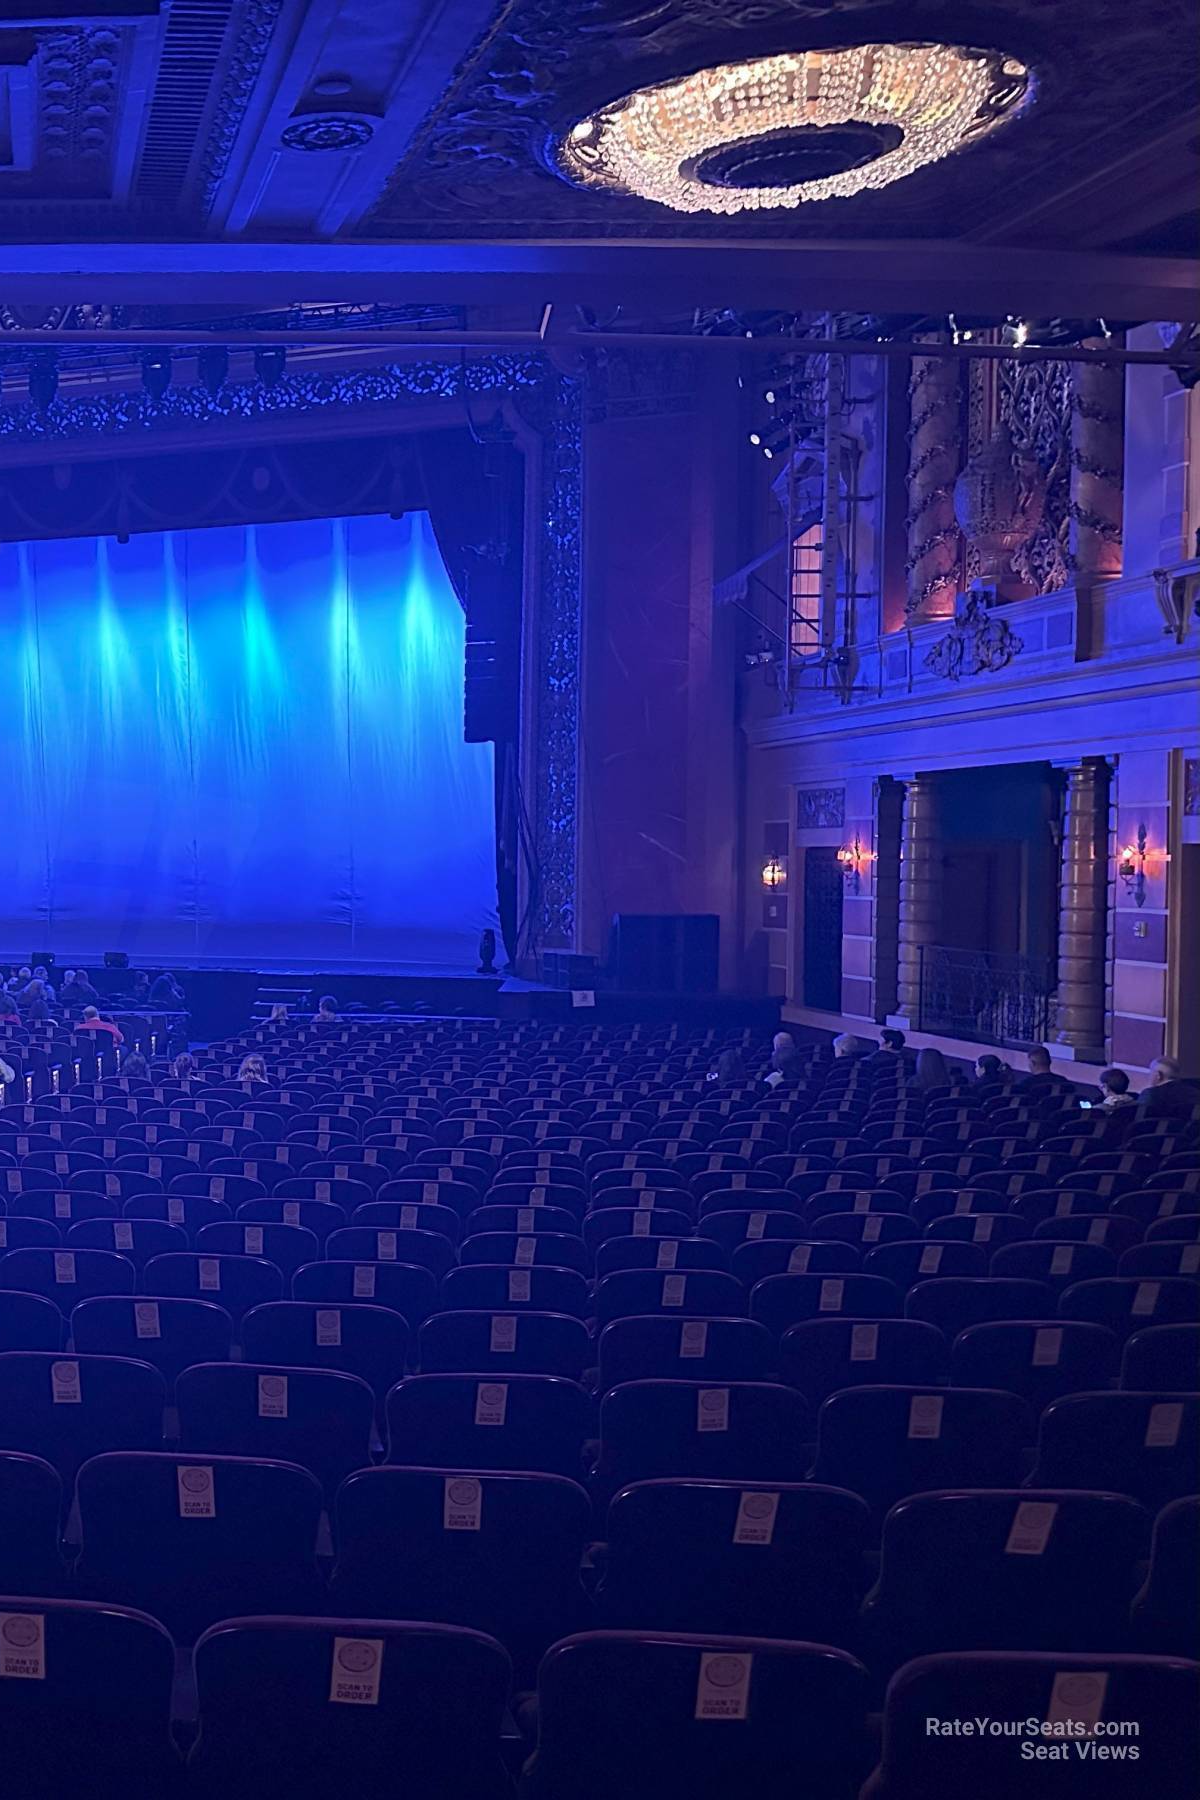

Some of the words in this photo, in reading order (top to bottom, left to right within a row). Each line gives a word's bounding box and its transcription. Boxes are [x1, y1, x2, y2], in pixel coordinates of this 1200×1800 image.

[4, 1665, 39, 1674] ORDER
[336, 1683, 361, 1691] SCAN
[336, 1690, 372, 1699] ORDER
[701, 1707, 740, 1715] ORDER
